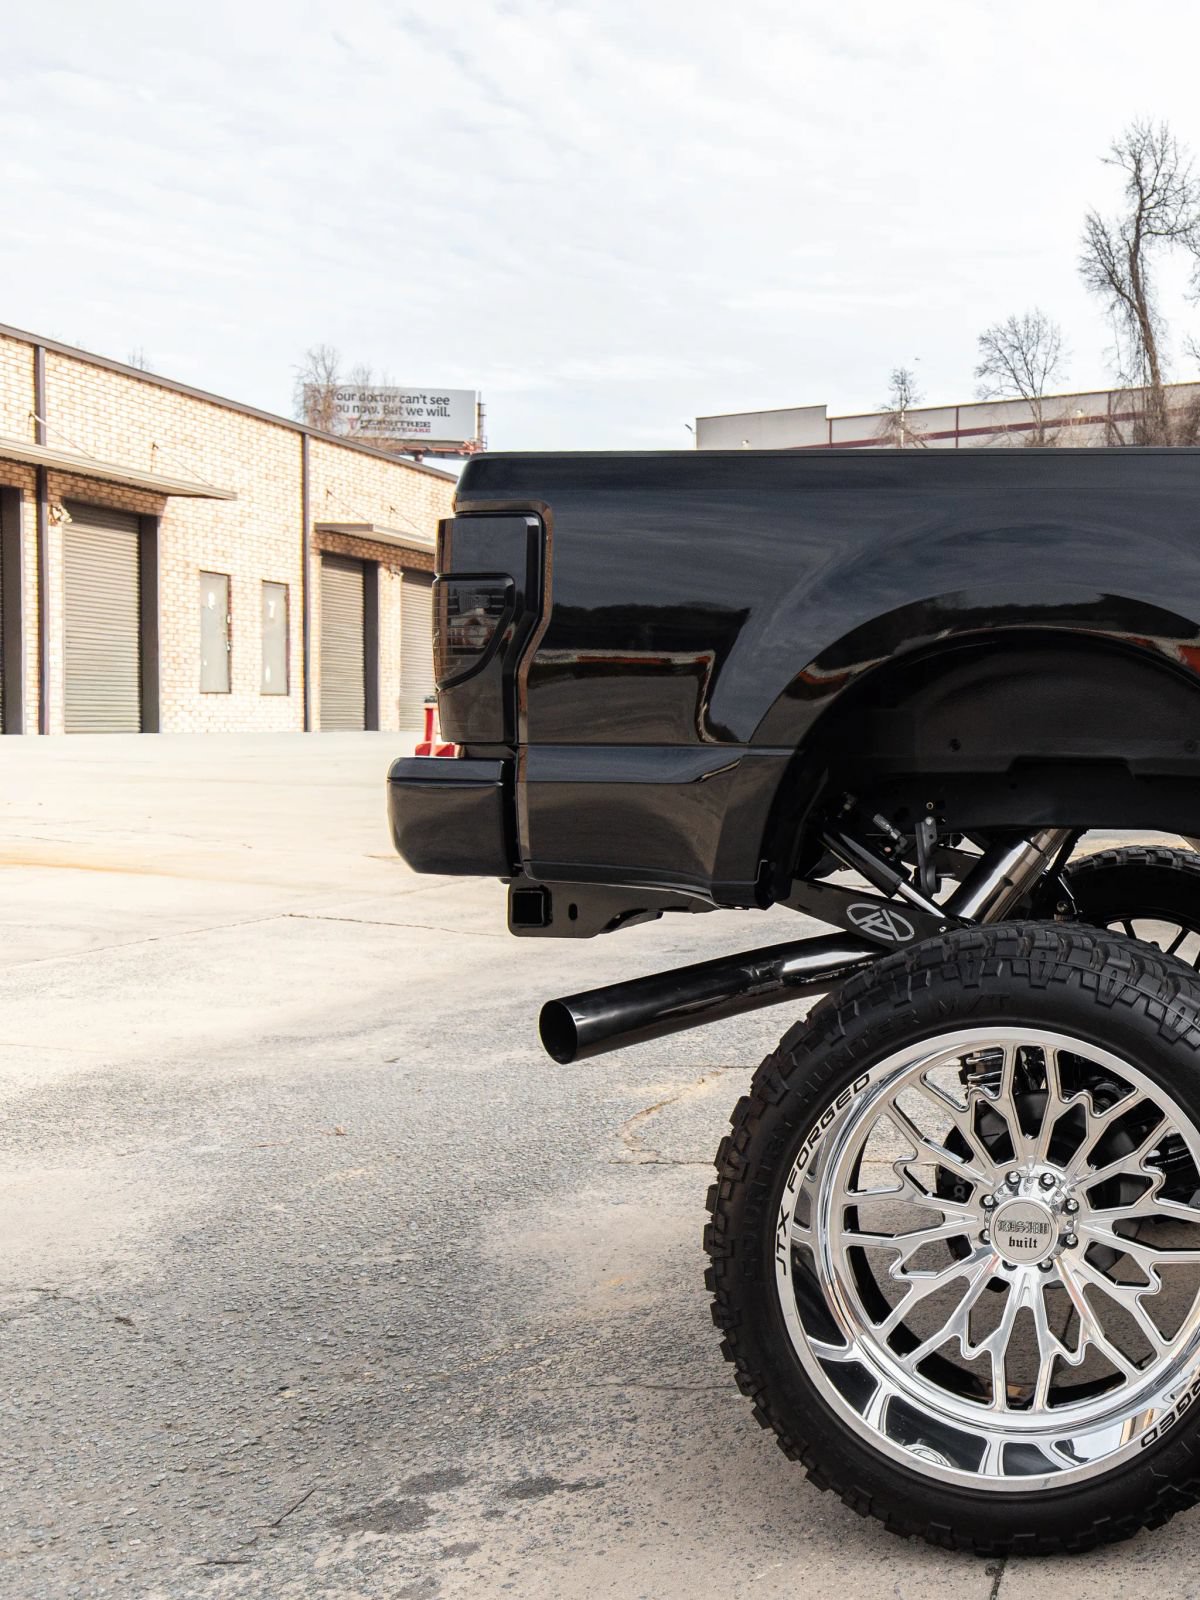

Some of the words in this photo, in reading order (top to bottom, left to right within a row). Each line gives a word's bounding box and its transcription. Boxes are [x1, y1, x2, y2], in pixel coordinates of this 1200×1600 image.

[332, 392, 357, 401] our
[359, 392, 396, 403] doctor
[400, 394, 427, 405] can't
[430, 396, 450, 405] see
[334, 404, 349, 413] ou
[353, 405, 380, 415] now.
[383, 405, 403, 416] But
[406, 407, 423, 416] we
[427, 405, 451, 417] will.
[775, 1204, 790, 1276] JTX
[787, 1073, 870, 1194] FORGED
[1008, 1236, 1038, 1248] built
